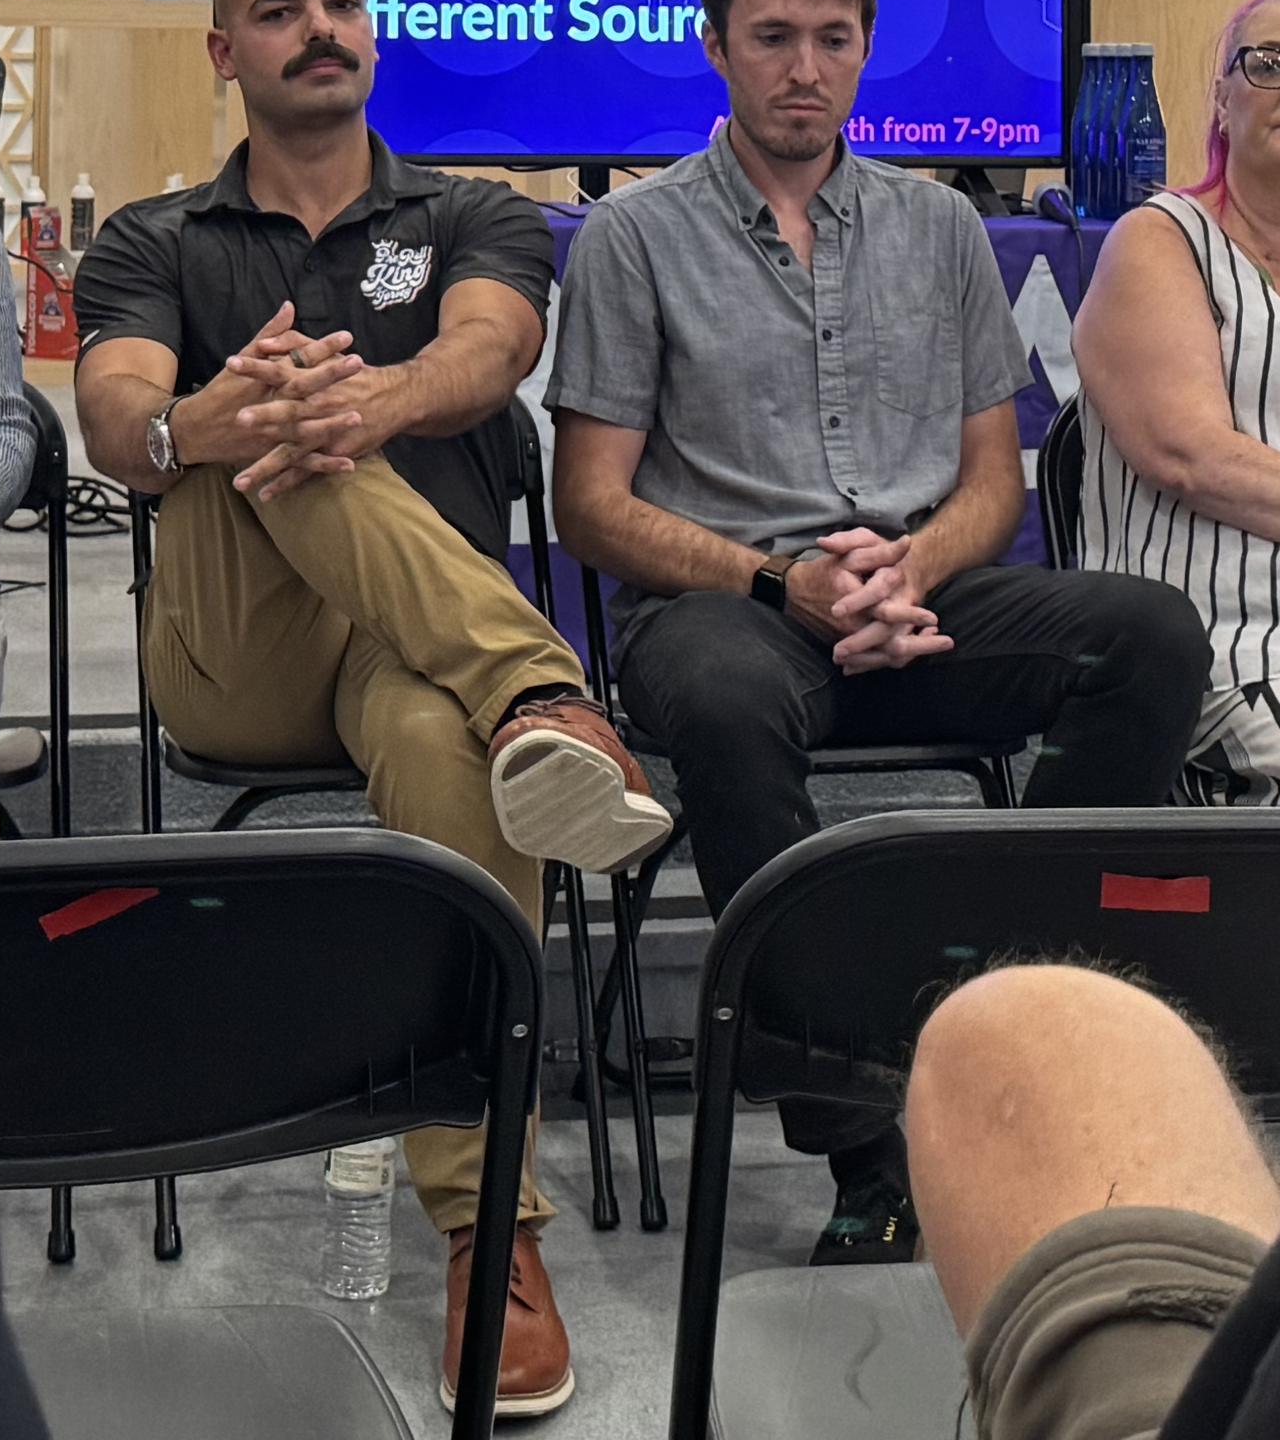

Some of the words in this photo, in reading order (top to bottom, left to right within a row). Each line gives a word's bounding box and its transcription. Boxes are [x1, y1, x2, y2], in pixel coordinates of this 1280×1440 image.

[841, 117, 875, 143] th
[883, 116, 946, 143] from
[952, 116, 1041, 148] 7-9pm
[360, 263, 427, 292] King
